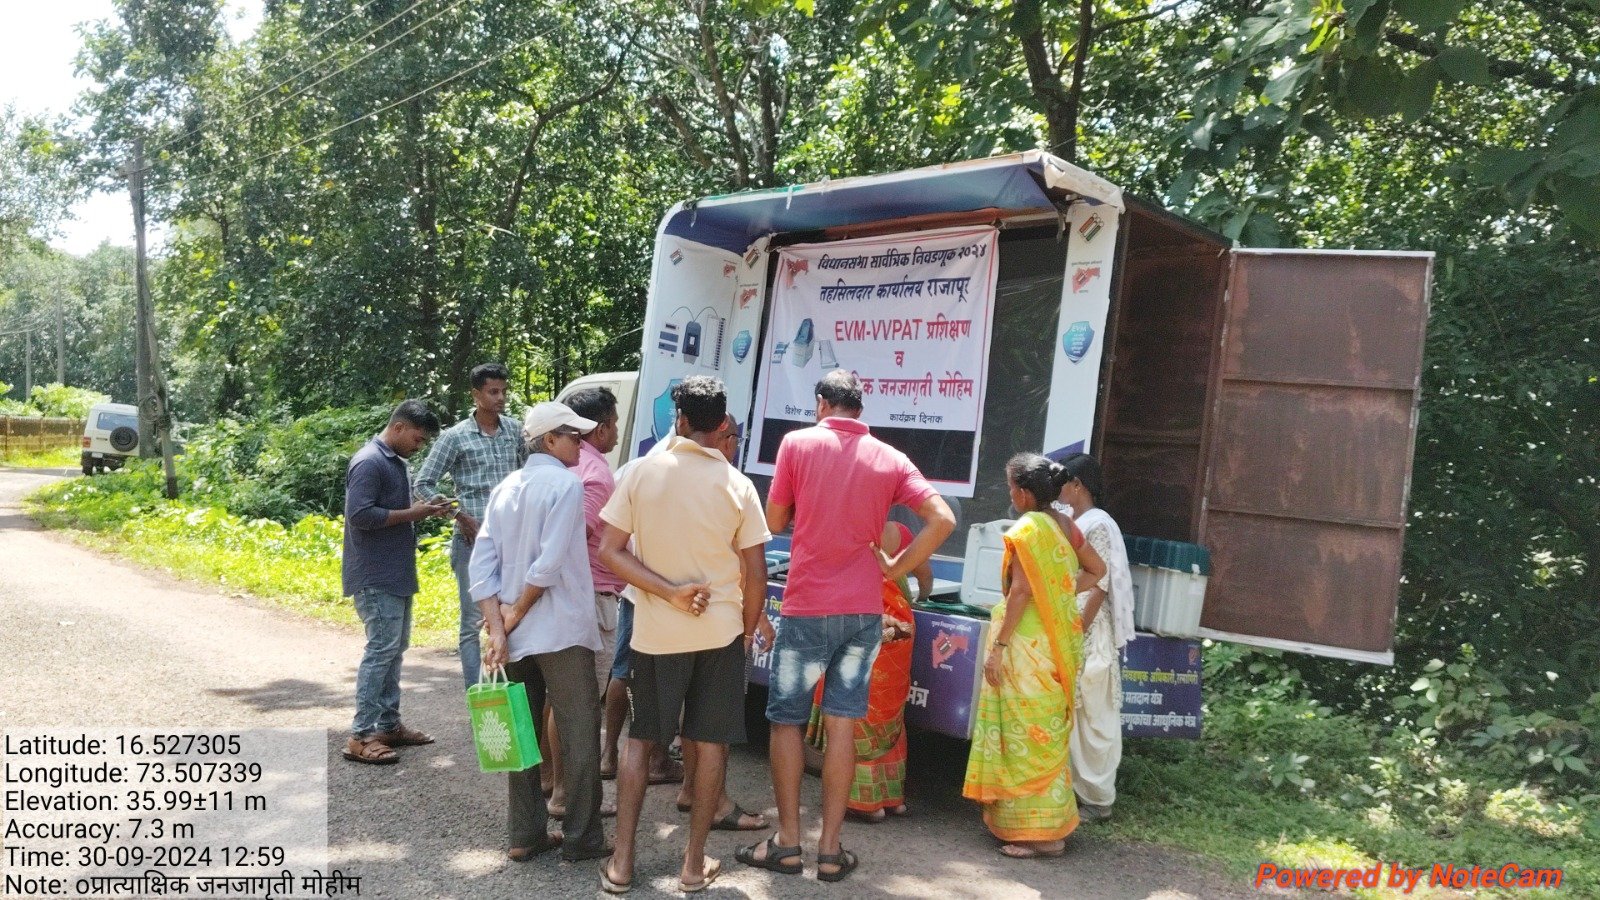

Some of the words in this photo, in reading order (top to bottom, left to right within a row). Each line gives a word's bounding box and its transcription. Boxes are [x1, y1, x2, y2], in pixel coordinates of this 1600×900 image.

[818, 253, 868, 270] विधानसभा
[870, 249, 910, 268] सार्वत्रिक
[911, 246, 956, 267] निवडणूक
[957, 244, 987, 259] २०२४
[819, 278, 875, 304] तहसिलदार
[876, 274, 924, 299] कार्यालय
[927, 276, 971, 303] राजापूर
[834, 318, 923, 342] EVM-VVPAT
[926, 312, 972, 341] प्रशिक्षण
[894, 350, 905, 368] व
[878, 371, 933, 406] जनजागृती
[937, 371, 974, 400] मोहिम
[889, 412, 916, 423] कार्यक्रम
[919, 412, 943, 424] दिनांक
[1125, 691, 1150, 705] मतदान
[1120, 710, 1152, 731] डणूकांचा
[1152, 711, 1184, 732] आधुनिक
